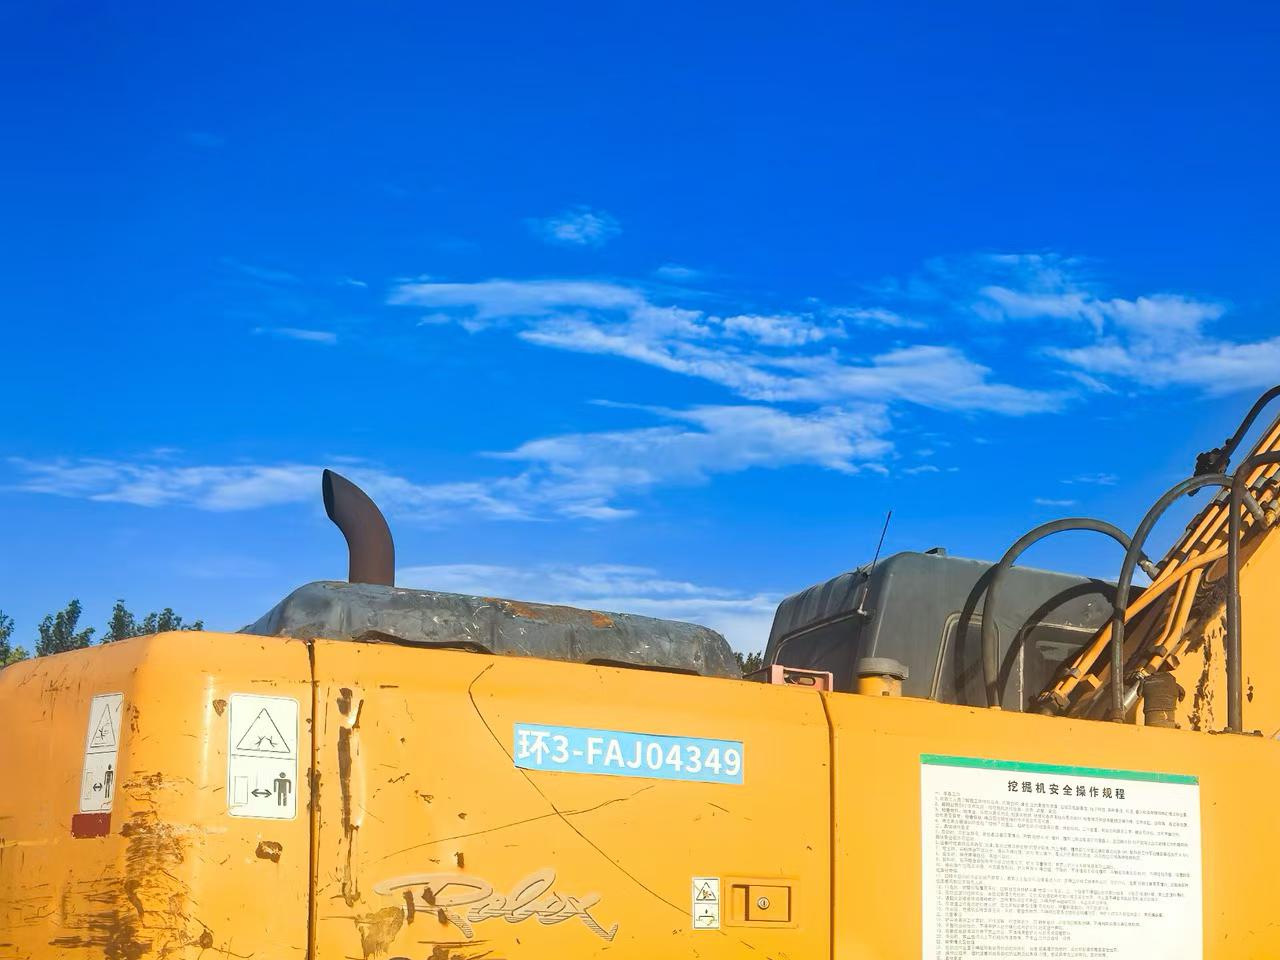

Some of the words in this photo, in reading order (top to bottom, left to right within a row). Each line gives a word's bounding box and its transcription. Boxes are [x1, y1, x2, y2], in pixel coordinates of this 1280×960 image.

[517, 728, 742, 777] 环3-FAJ04349
[1007, 779, 1126, 800] 挖掘机安全操作规程
